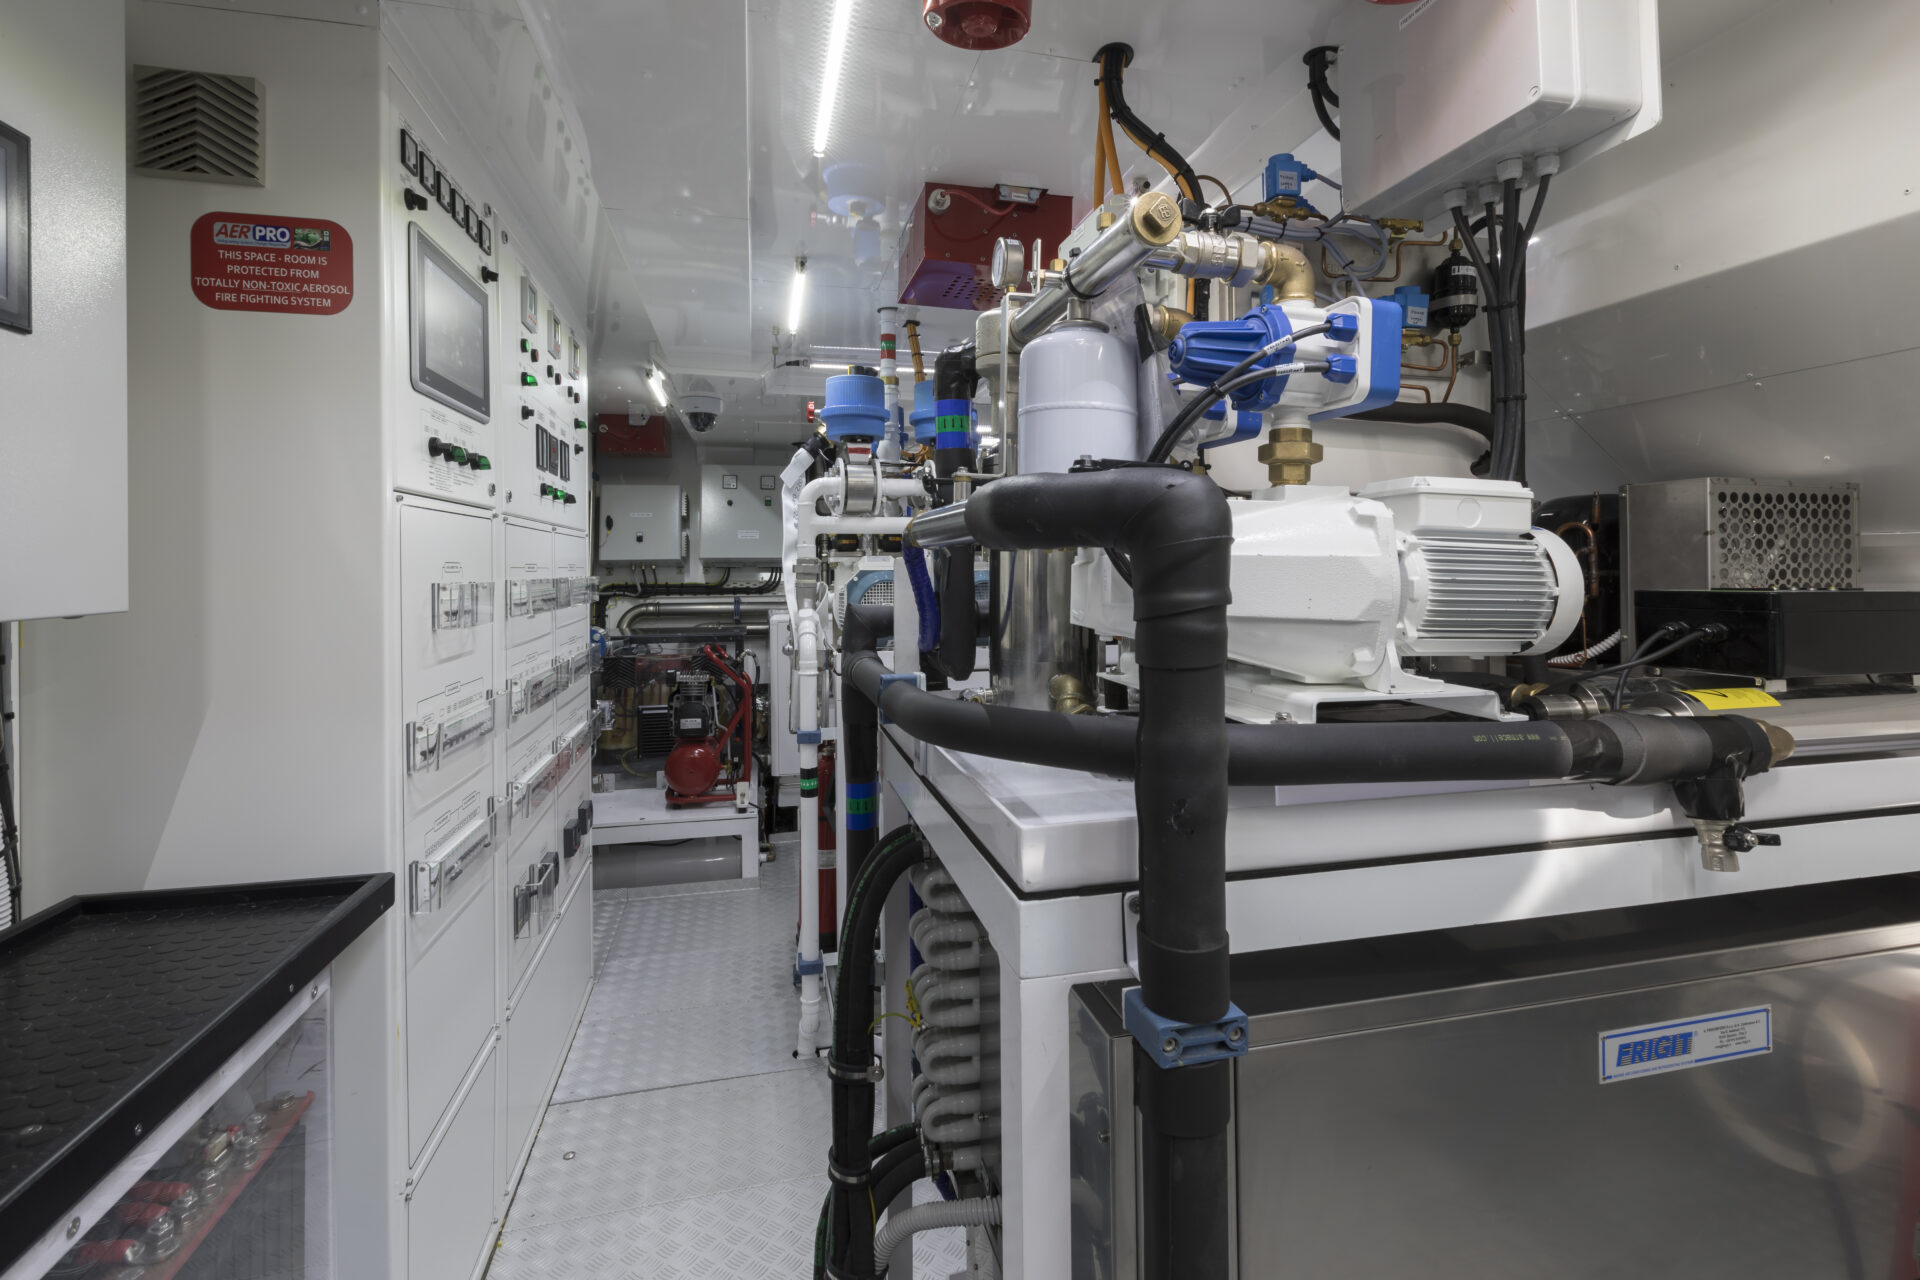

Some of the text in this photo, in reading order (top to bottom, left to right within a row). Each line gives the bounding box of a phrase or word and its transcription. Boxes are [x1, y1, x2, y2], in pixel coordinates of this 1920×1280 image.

[217, 249, 242, 260] THIS
[243, 251, 276, 262] SPACE
[284, 254, 316, 264] ROOM
[318, 256, 328, 265] IS
[227, 265, 319, 279] PROTECTED FROM
[194, 276, 350, 295] TOTALLY NON-TOXIC AEROSOL
[215, 292, 331, 307] FIRE FIGHTING SYSTEM
[1615, 1031, 1693, 1067] FRIGIT
